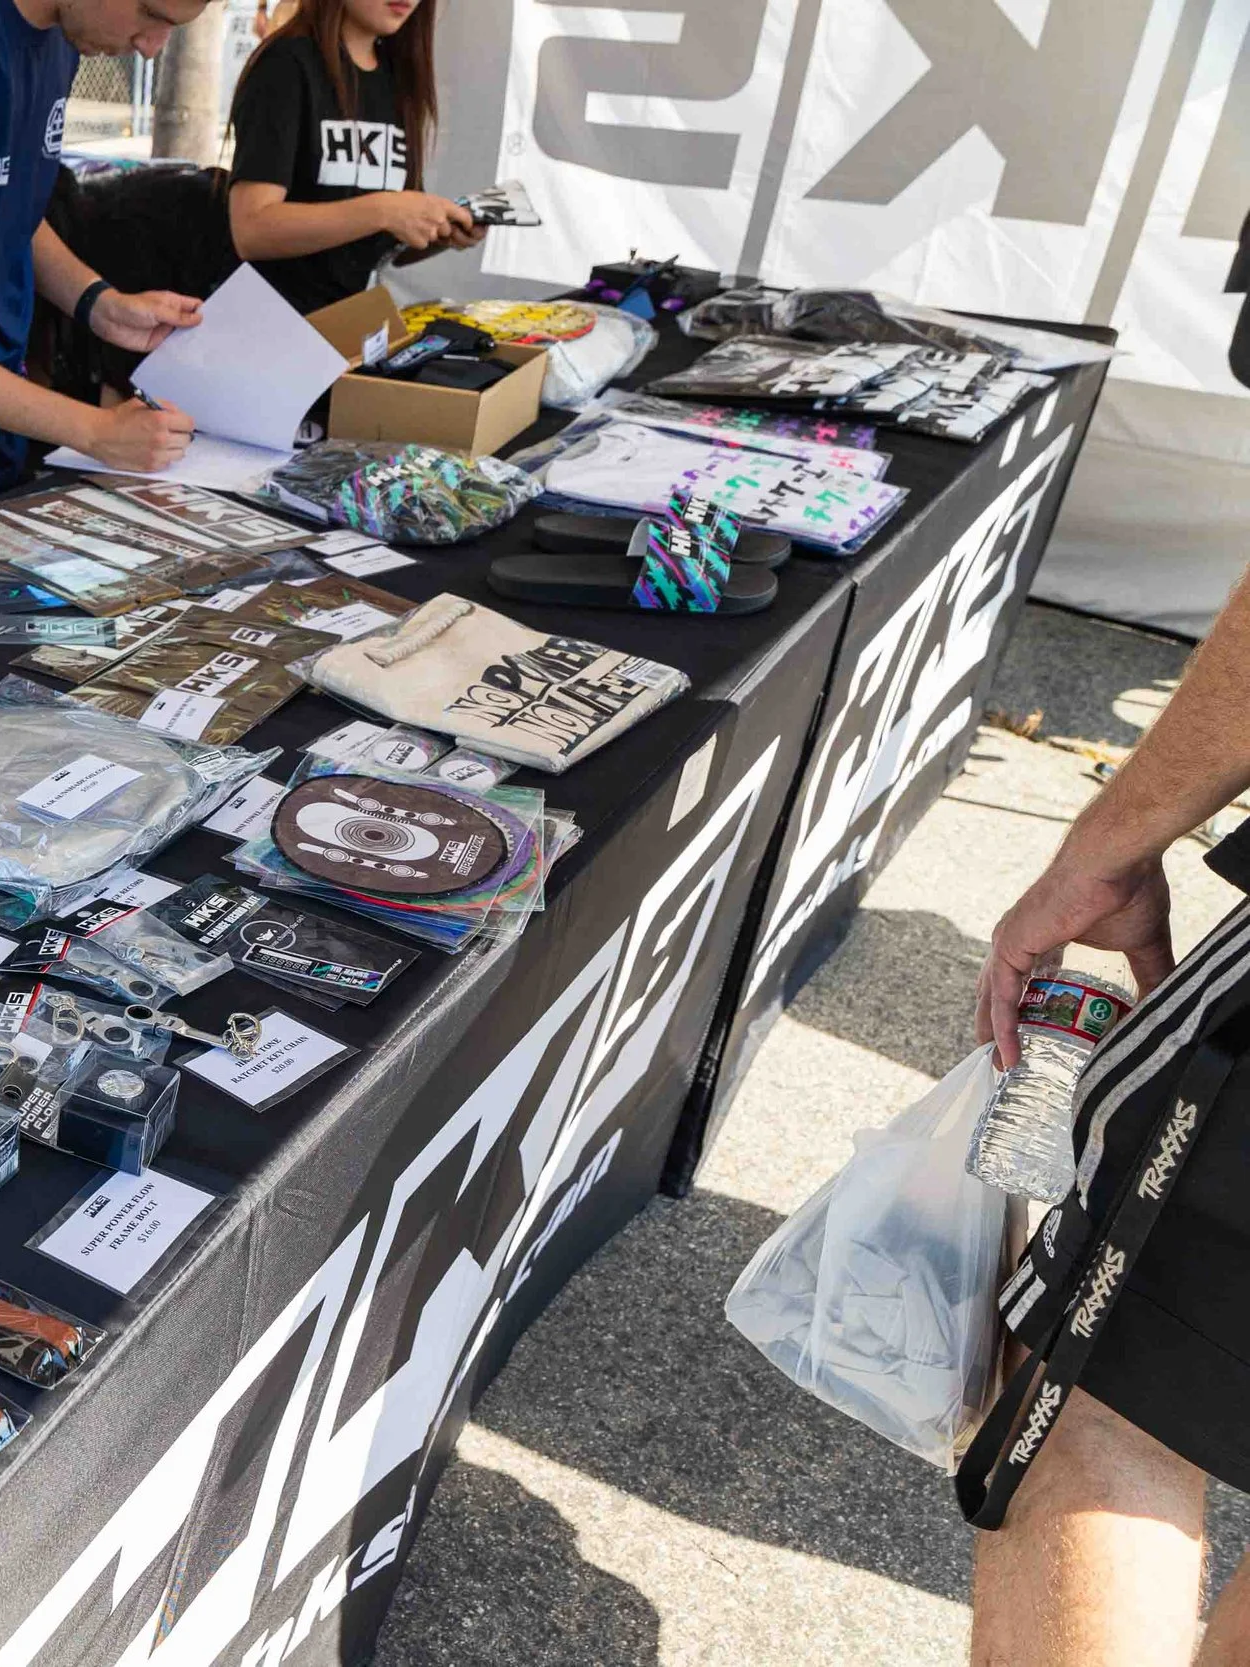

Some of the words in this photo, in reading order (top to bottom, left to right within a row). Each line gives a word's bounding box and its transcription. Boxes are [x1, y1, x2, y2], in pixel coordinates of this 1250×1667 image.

[150, 484, 289, 539] HKS
[180, 653, 246, 692] HKS
[386, 742, 414, 764] HKS
[447, 763, 487, 780] HKS
[438, 841, 459, 861] HKS
[78, 907, 120, 929] HKS
[183, 894, 228, 927] HKS
[206, 920, 231, 938] CHANGE
[224, 906, 247, 923] RECORD
[241, 895, 260, 909] PLATE
[39, 928, 65, 957] HKS
[230, 1058, 269, 1083] RATCHET
[267, 1048, 284, 1060] KEY
[283, 1035, 308, 1051] CHAIN
[259, 1037, 281, 1052] TONE
[271, 1057, 294, 1074] $20.00
[20, 1091, 53, 1129] POWER
[33, 1100, 59, 1128] FLOW
[1138, 1099, 1198, 1200] TRAXXAS
[80, 1229, 108, 1257] SUPER
[104, 1201, 135, 1232] POWER
[131, 1180, 155, 1205] FLOW
[84, 1192, 110, 1219] HKS
[108, 1219, 139, 1250] FRAME
[135, 1198, 158, 1221] BOLT
[136, 1218, 162, 1244] $16.00
[1070, 1246, 1125, 1339] TRAXXAS
[1009, 1381, 1061, 1465] TRAXXAS
